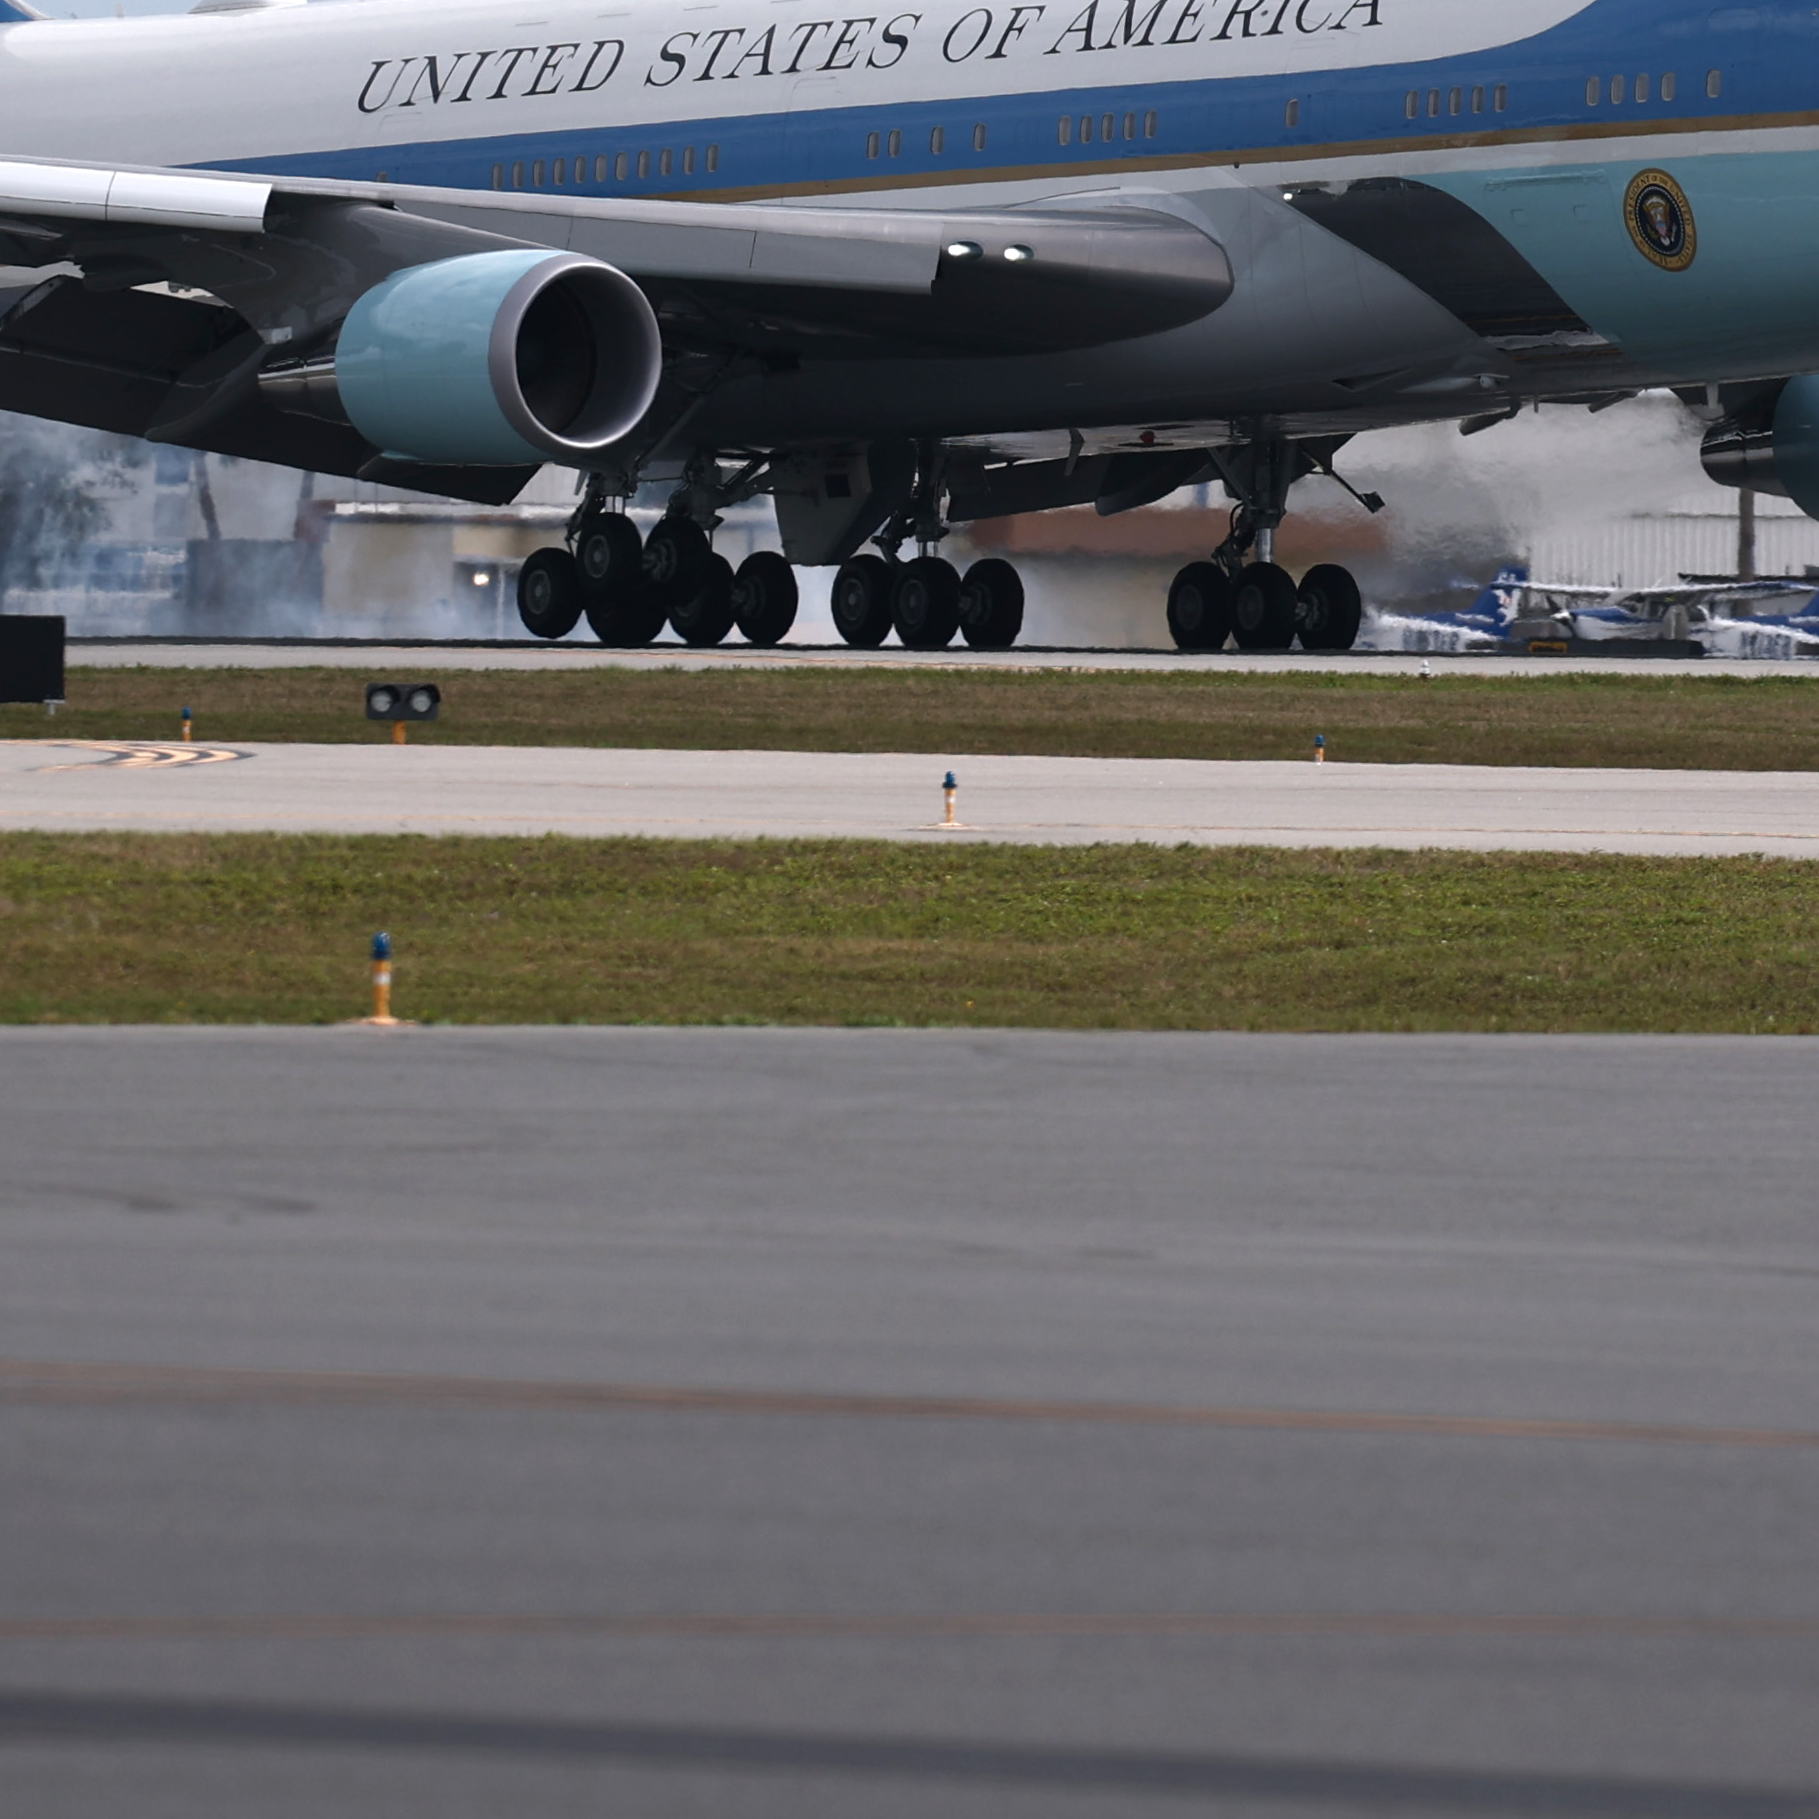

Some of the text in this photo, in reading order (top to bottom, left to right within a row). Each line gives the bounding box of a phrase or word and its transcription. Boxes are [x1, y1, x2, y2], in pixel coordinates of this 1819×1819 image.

[357, 39, 625, 113] UNITED
[644, 13, 923, 87] STATES
[942, 5, 1046, 63] OF
